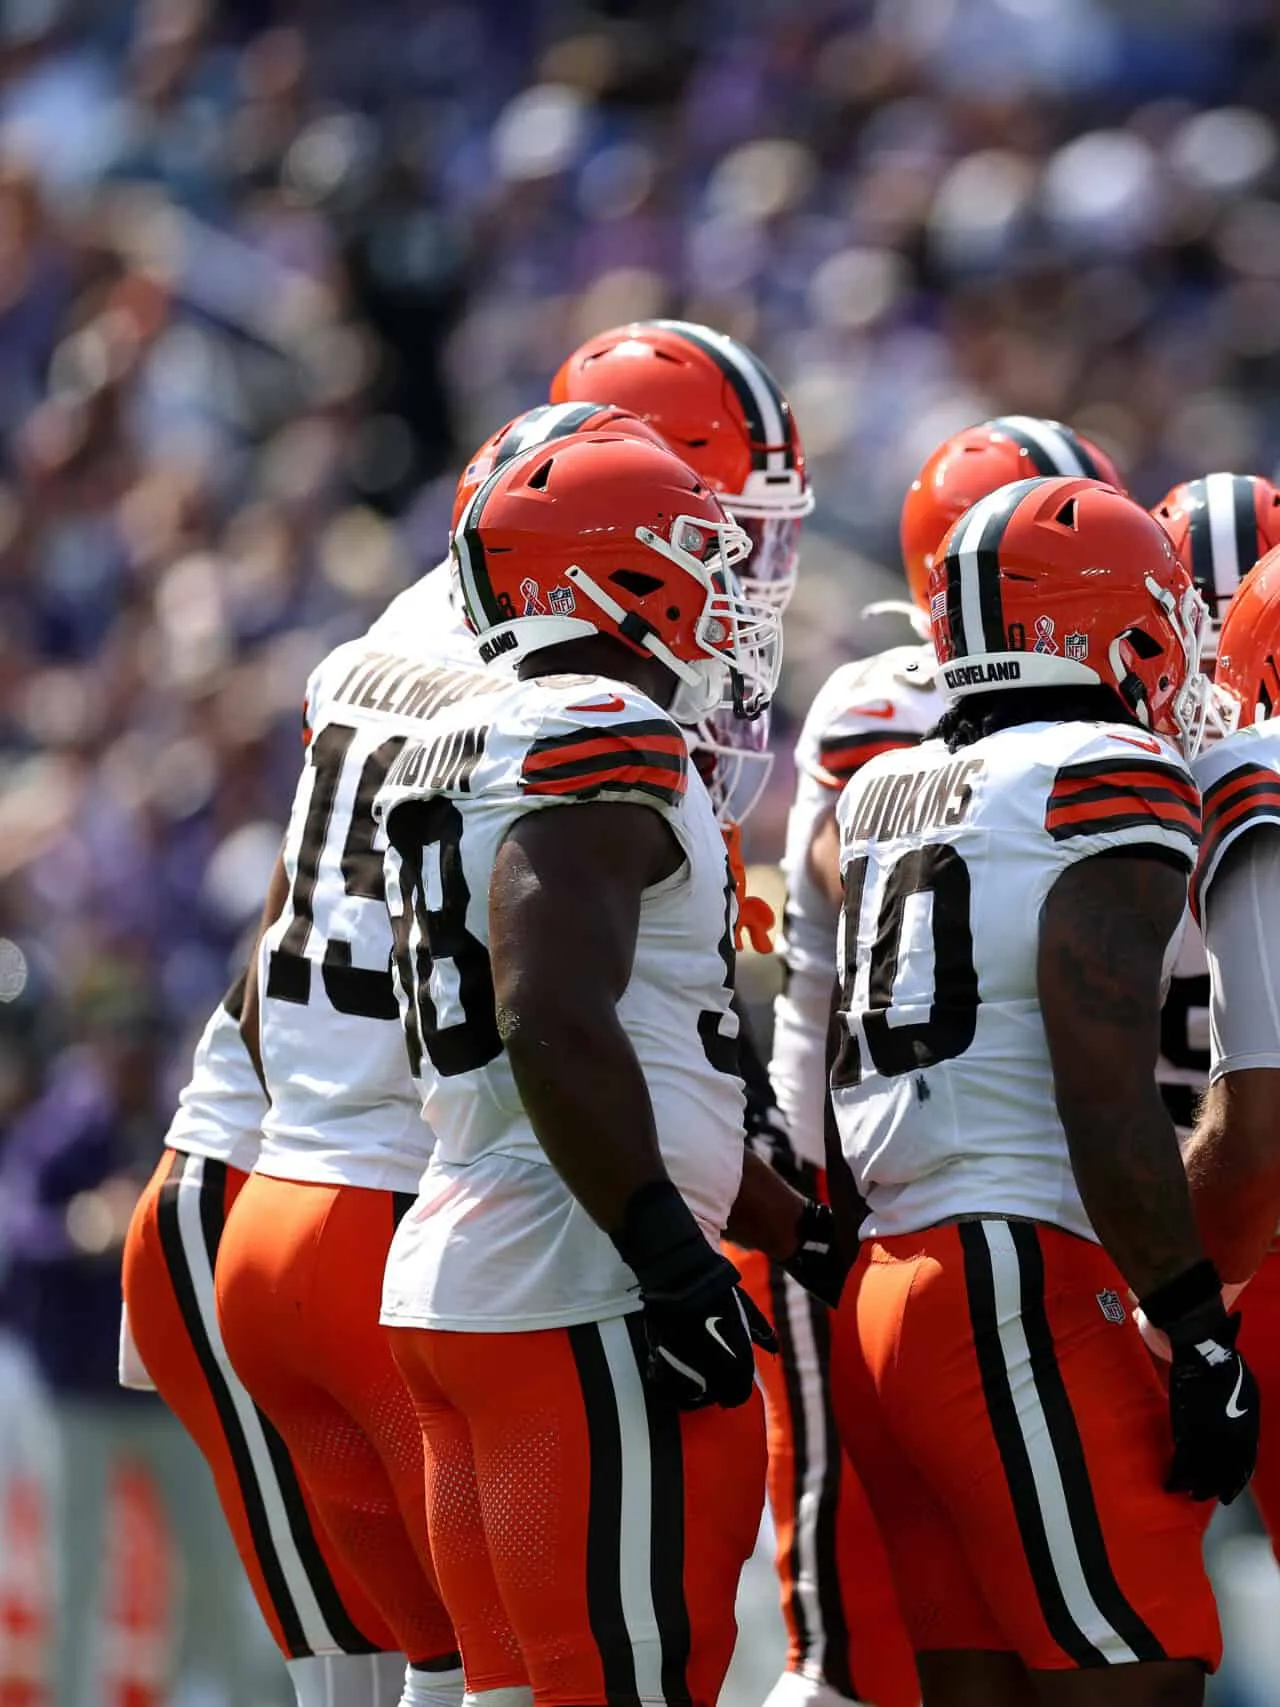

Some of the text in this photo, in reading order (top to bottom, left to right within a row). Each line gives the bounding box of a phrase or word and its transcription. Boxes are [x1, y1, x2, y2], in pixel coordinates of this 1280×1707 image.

[553, 599, 574, 613] NFL
[1068, 645, 1086, 658] NFL
[944, 661, 1021, 689] CLEVELAND
[844, 758, 985, 847] JUDKINS
[830, 843, 983, 1090] 10
